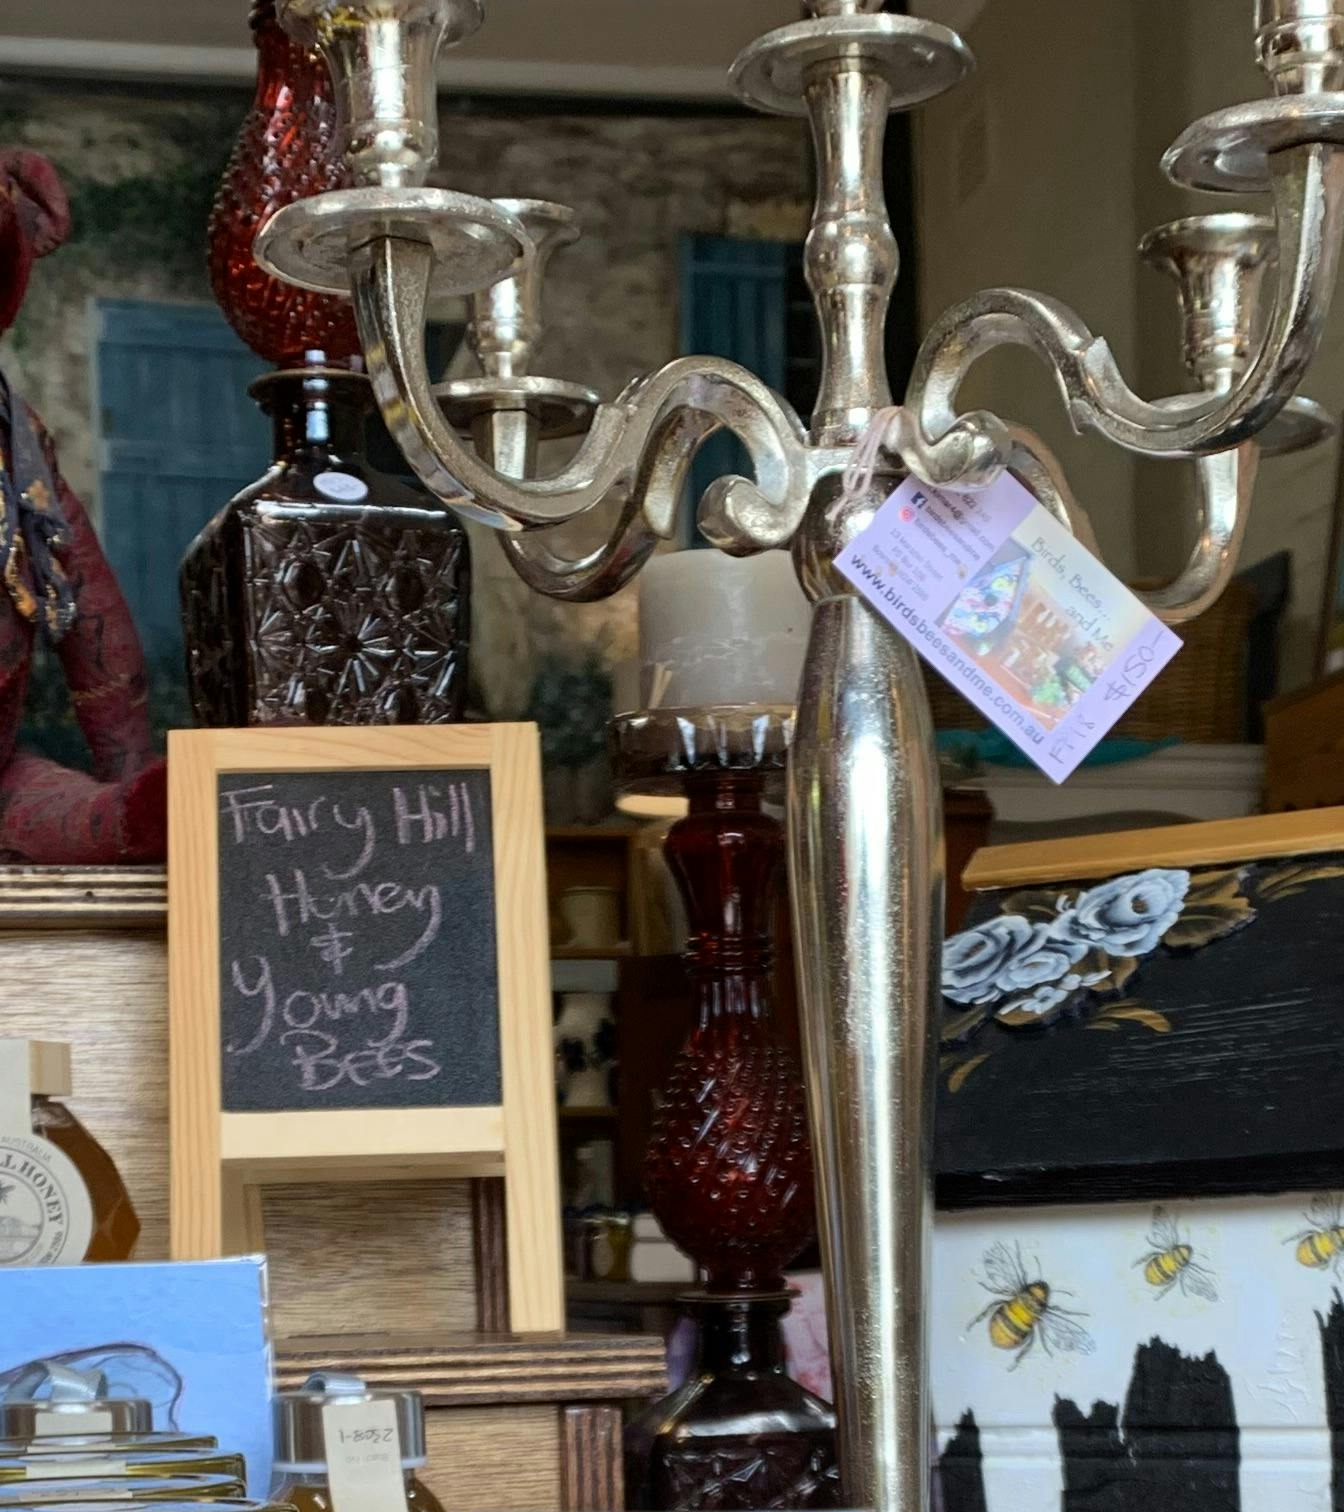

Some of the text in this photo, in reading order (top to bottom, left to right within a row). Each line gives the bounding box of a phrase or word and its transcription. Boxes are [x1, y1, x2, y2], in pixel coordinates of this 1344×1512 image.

[1030, 535, 1067, 579] Birds,
[851, 553, 1045, 745] www.birdsbeesandme.com.au
[1065, 605, 1092, 633] and
[220, 782, 475, 880] Fairy Hill
[261, 869, 441, 971] Honey
[227, 955, 409, 1056] Young
[20, 1161, 64, 1225] HONEY
